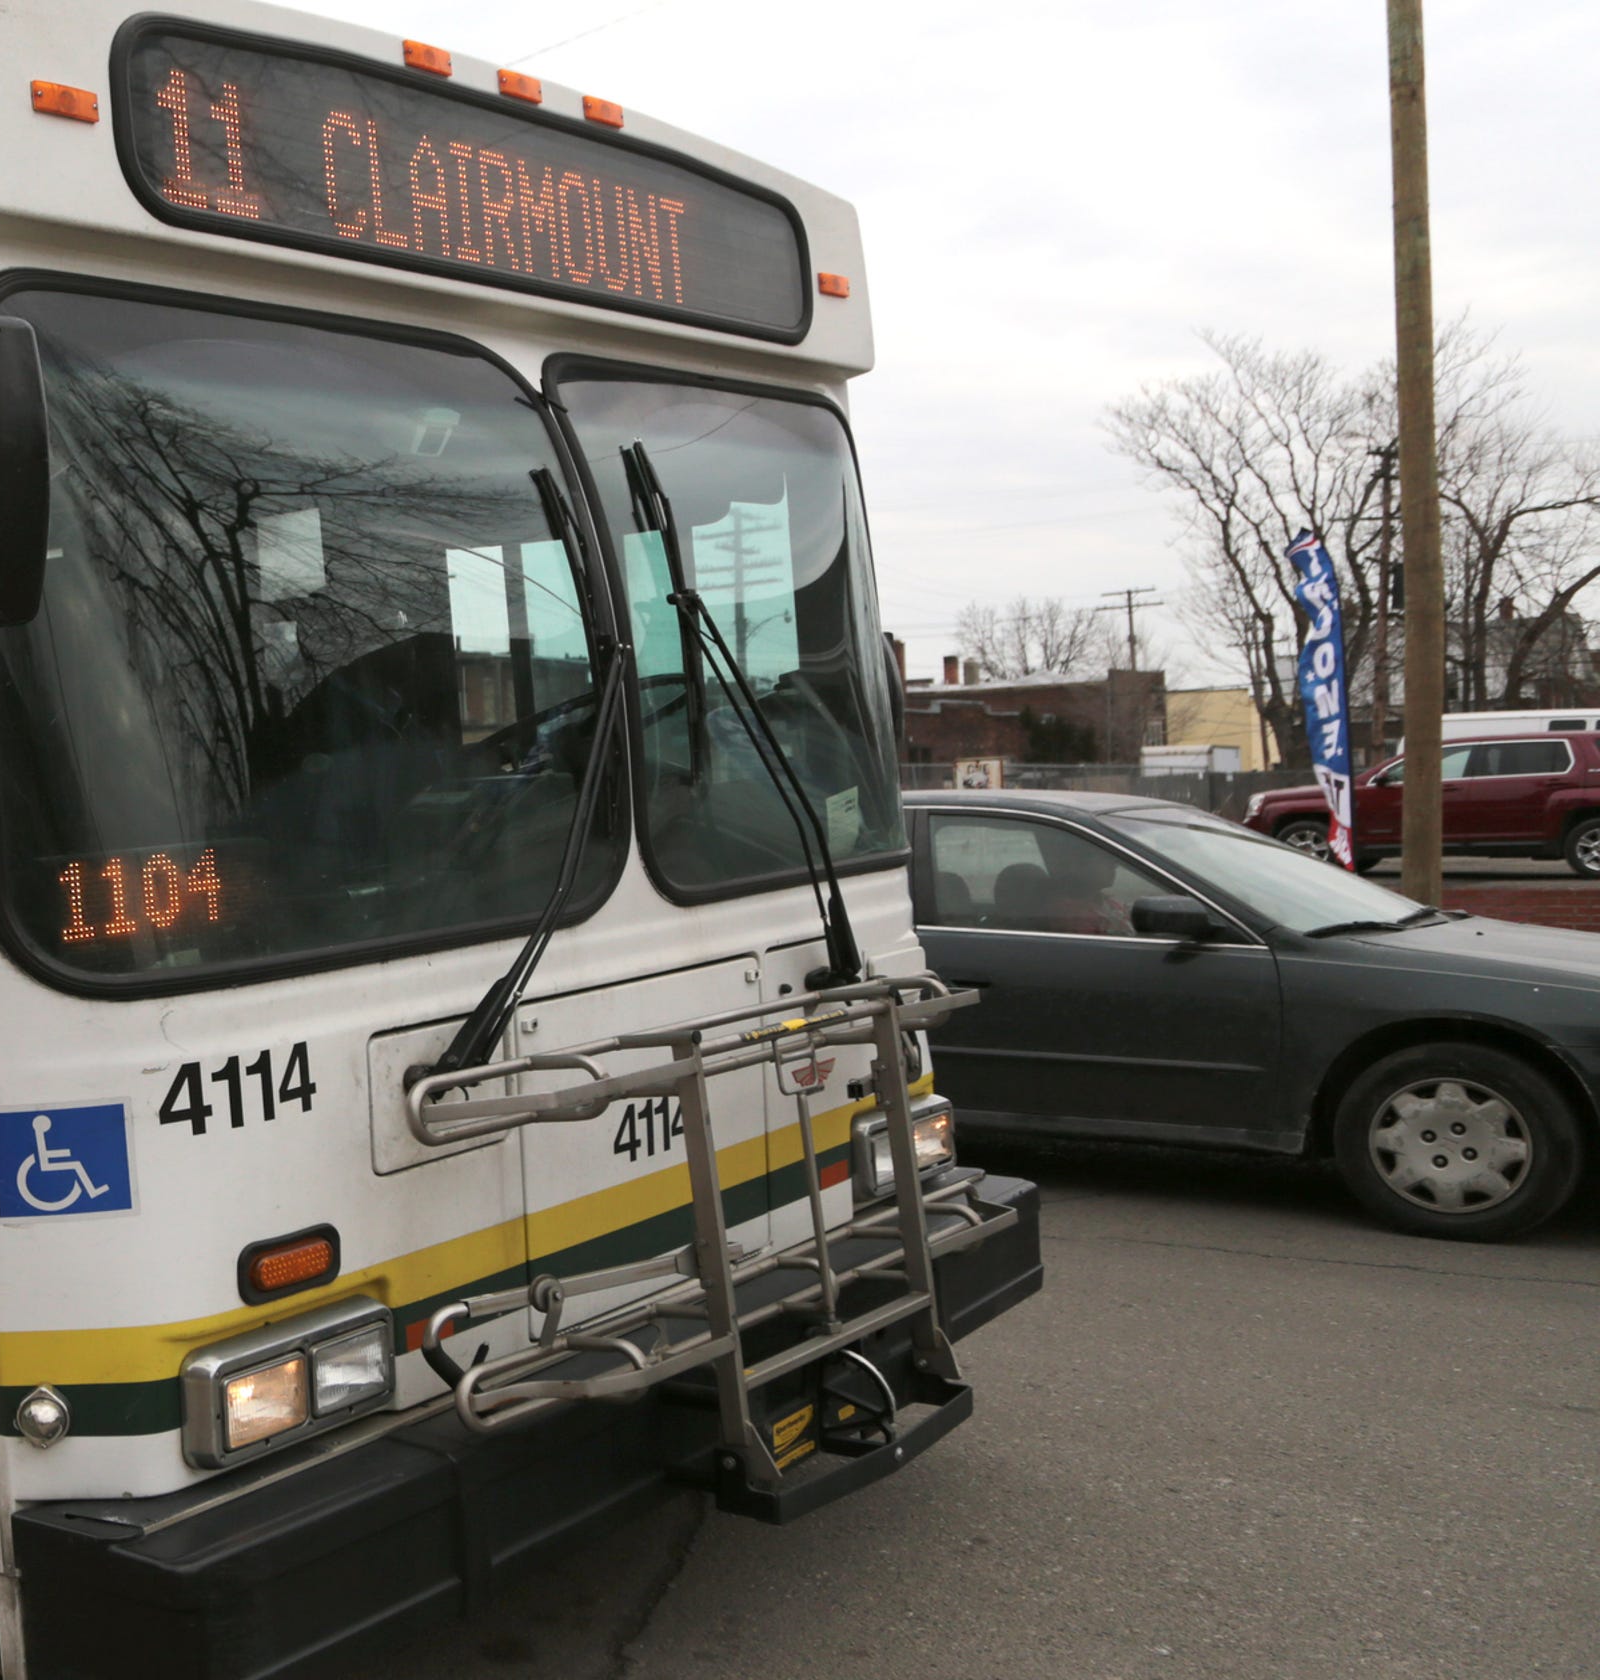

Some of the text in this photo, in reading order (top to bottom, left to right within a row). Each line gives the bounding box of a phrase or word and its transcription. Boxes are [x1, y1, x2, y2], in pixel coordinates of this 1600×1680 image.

[155, 67, 686, 306] 11 CLAIRMOUNT
[58, 847, 222, 944] 1104
[158, 1040, 317, 1136] 4114
